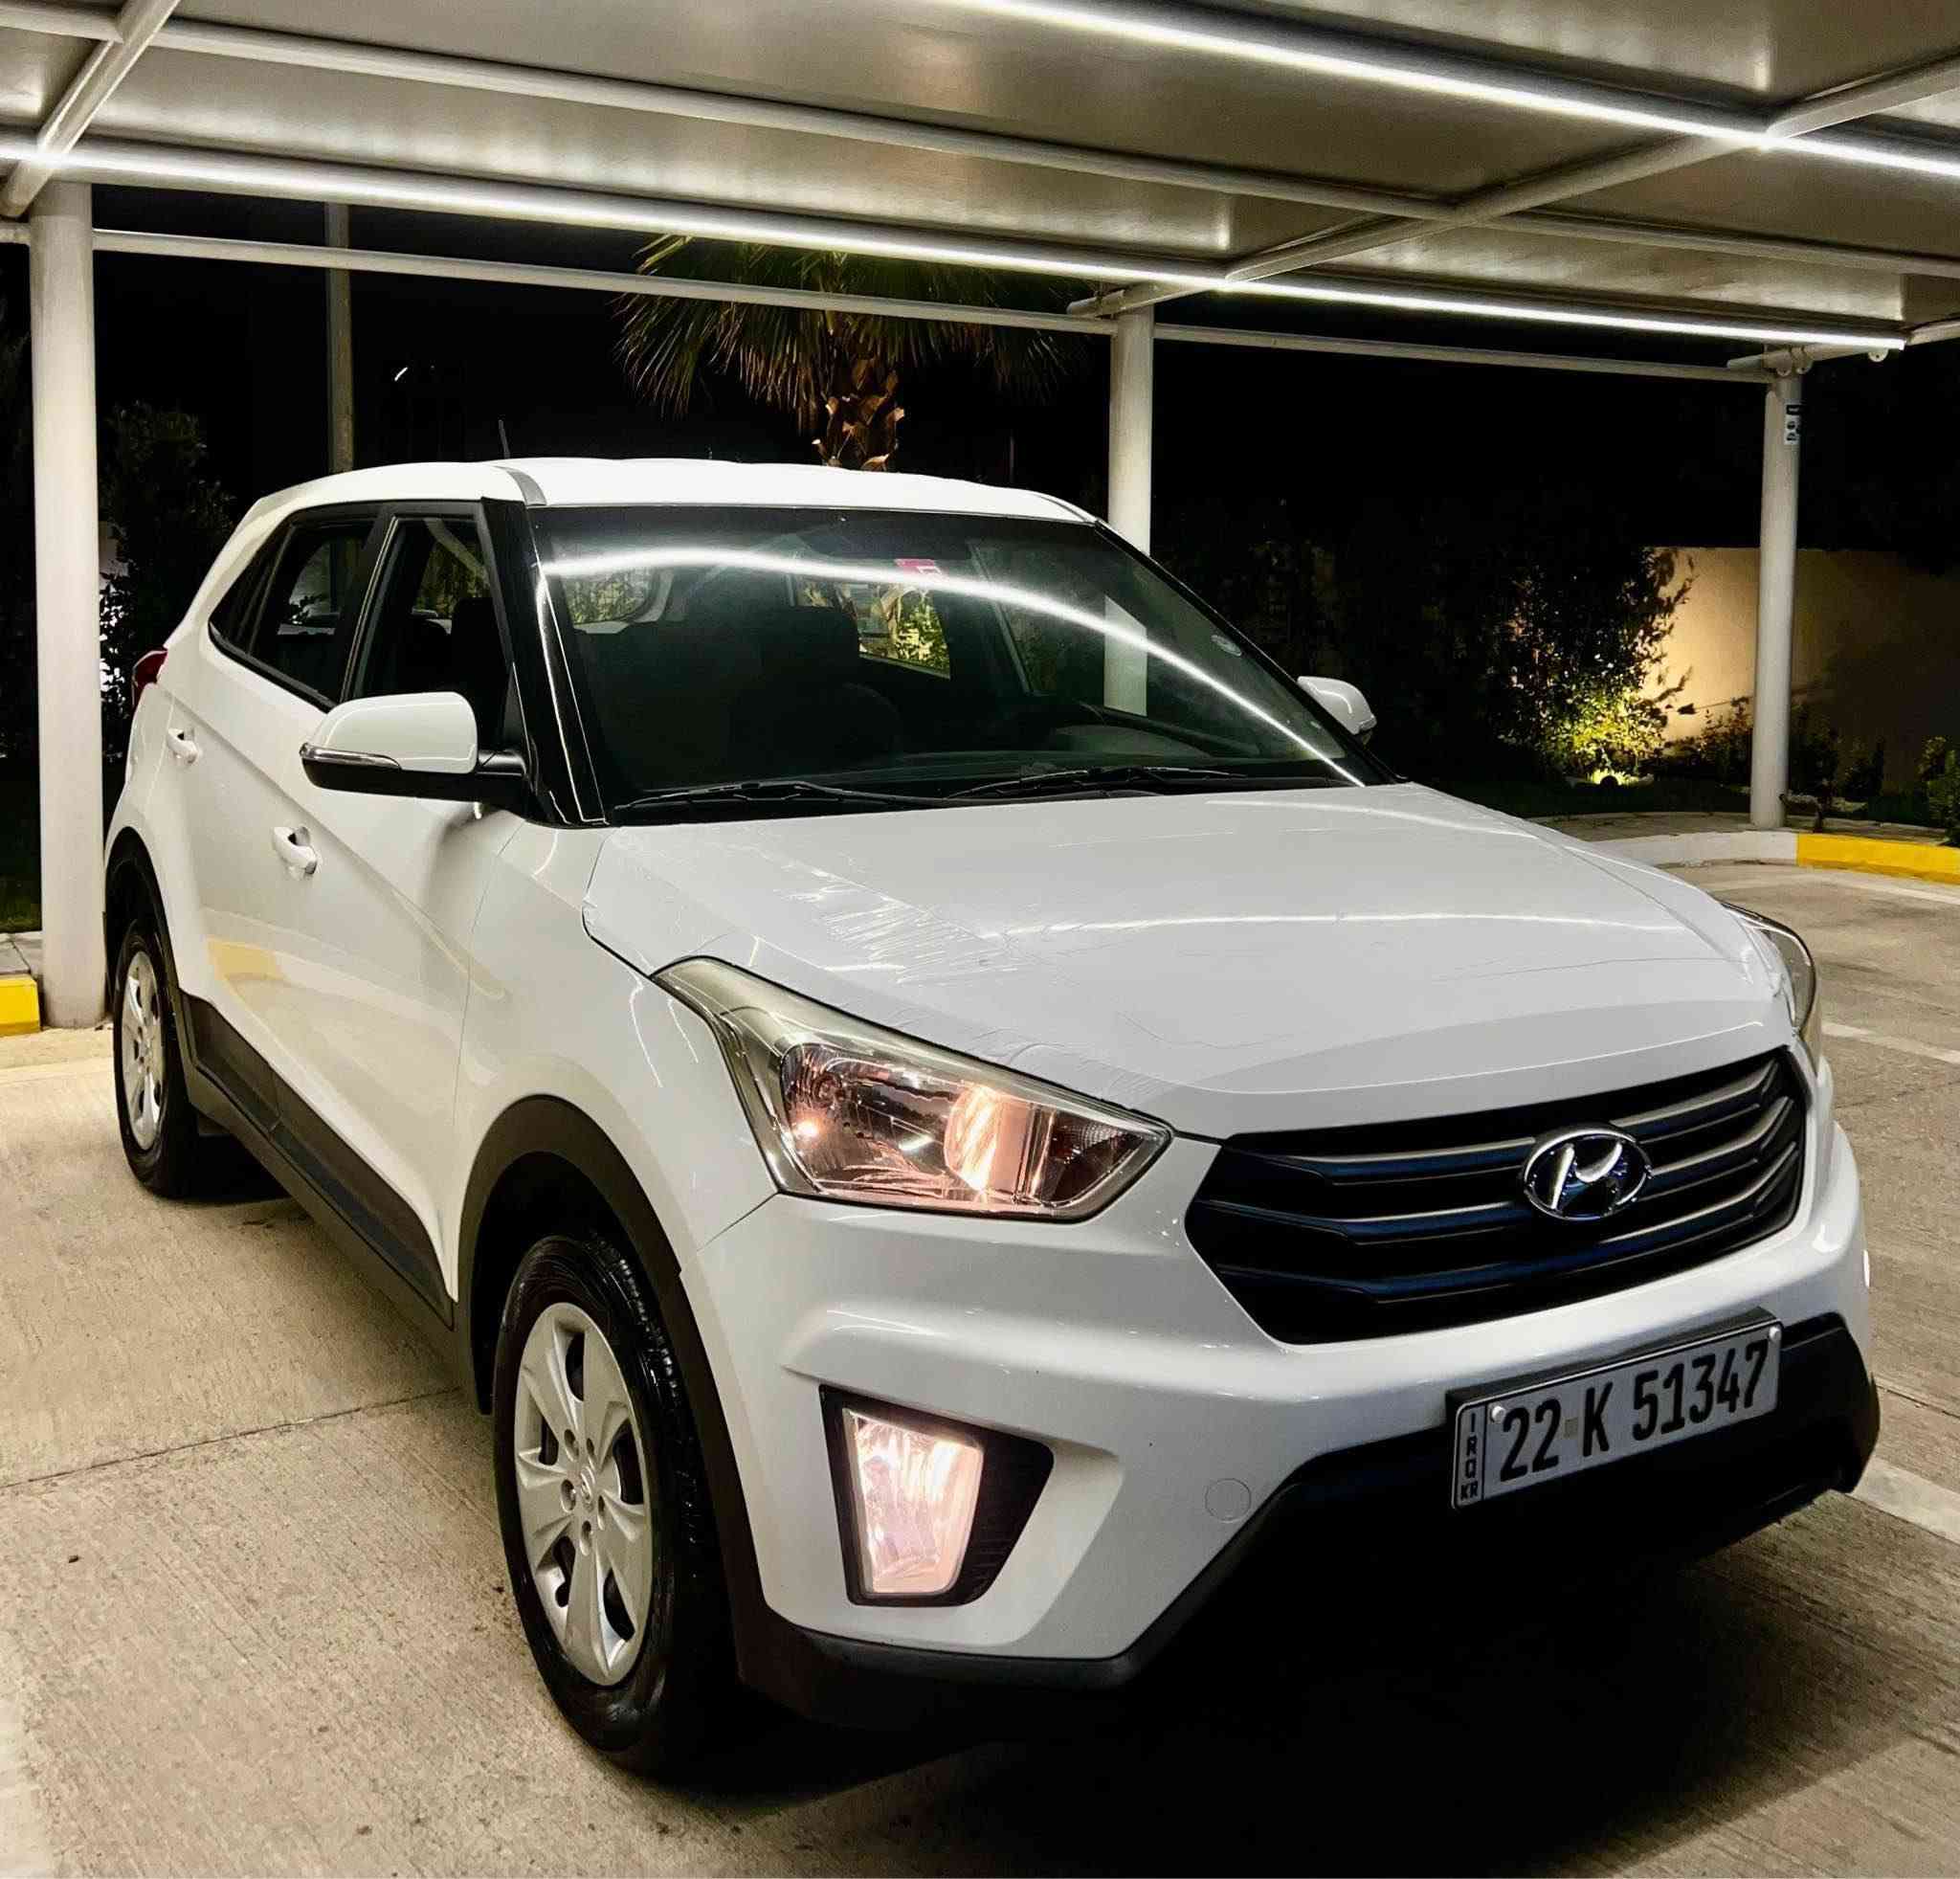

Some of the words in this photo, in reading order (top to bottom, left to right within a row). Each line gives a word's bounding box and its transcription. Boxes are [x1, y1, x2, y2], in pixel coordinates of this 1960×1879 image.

[1500, 1399, 1562, 1482] 22
[1583, 1382, 1614, 1458] K
[1632, 1338, 1769, 1442] 51347
